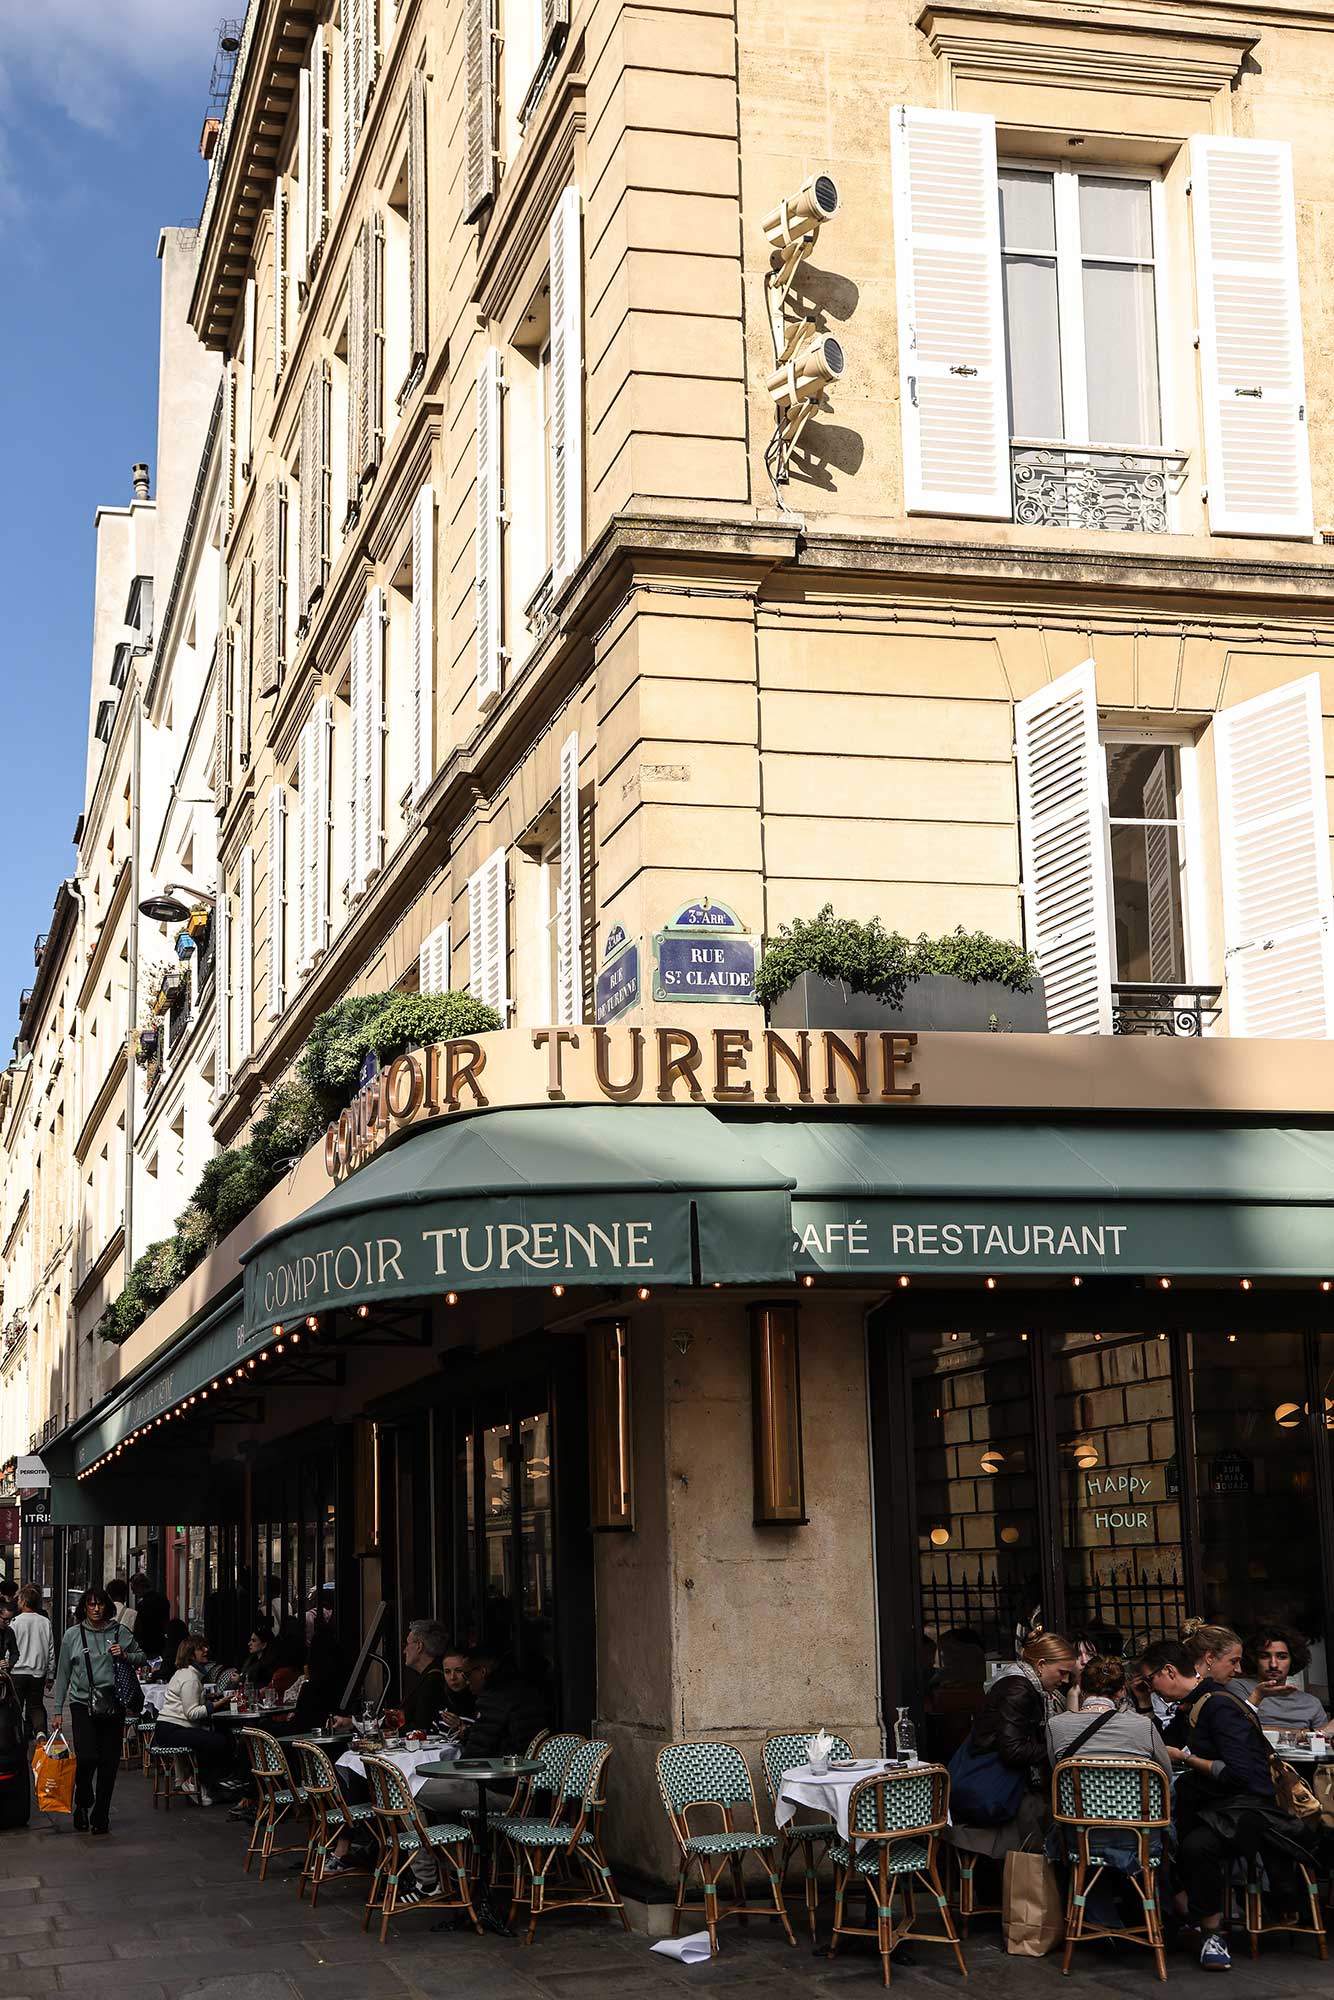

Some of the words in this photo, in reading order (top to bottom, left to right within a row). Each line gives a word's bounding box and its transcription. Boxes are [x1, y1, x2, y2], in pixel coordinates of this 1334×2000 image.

[691, 948, 725, 964] RUE
[610, 967, 623, 989] RUE
[686, 971, 751, 987] CLAUDE
[606, 977, 637, 1013] TURENNE
[531, 1026, 921, 1098] TURENNE
[792, 1219, 870, 1254] AFÉ
[892, 1223, 1127, 1255] RESTAURANT
[264, 1238, 405, 1312] COMPTOIR
[422, 1221, 654, 1276] TURENNE
[1087, 1476, 1152, 1496] HAPPY
[1095, 1512, 1148, 1529] HOUR
